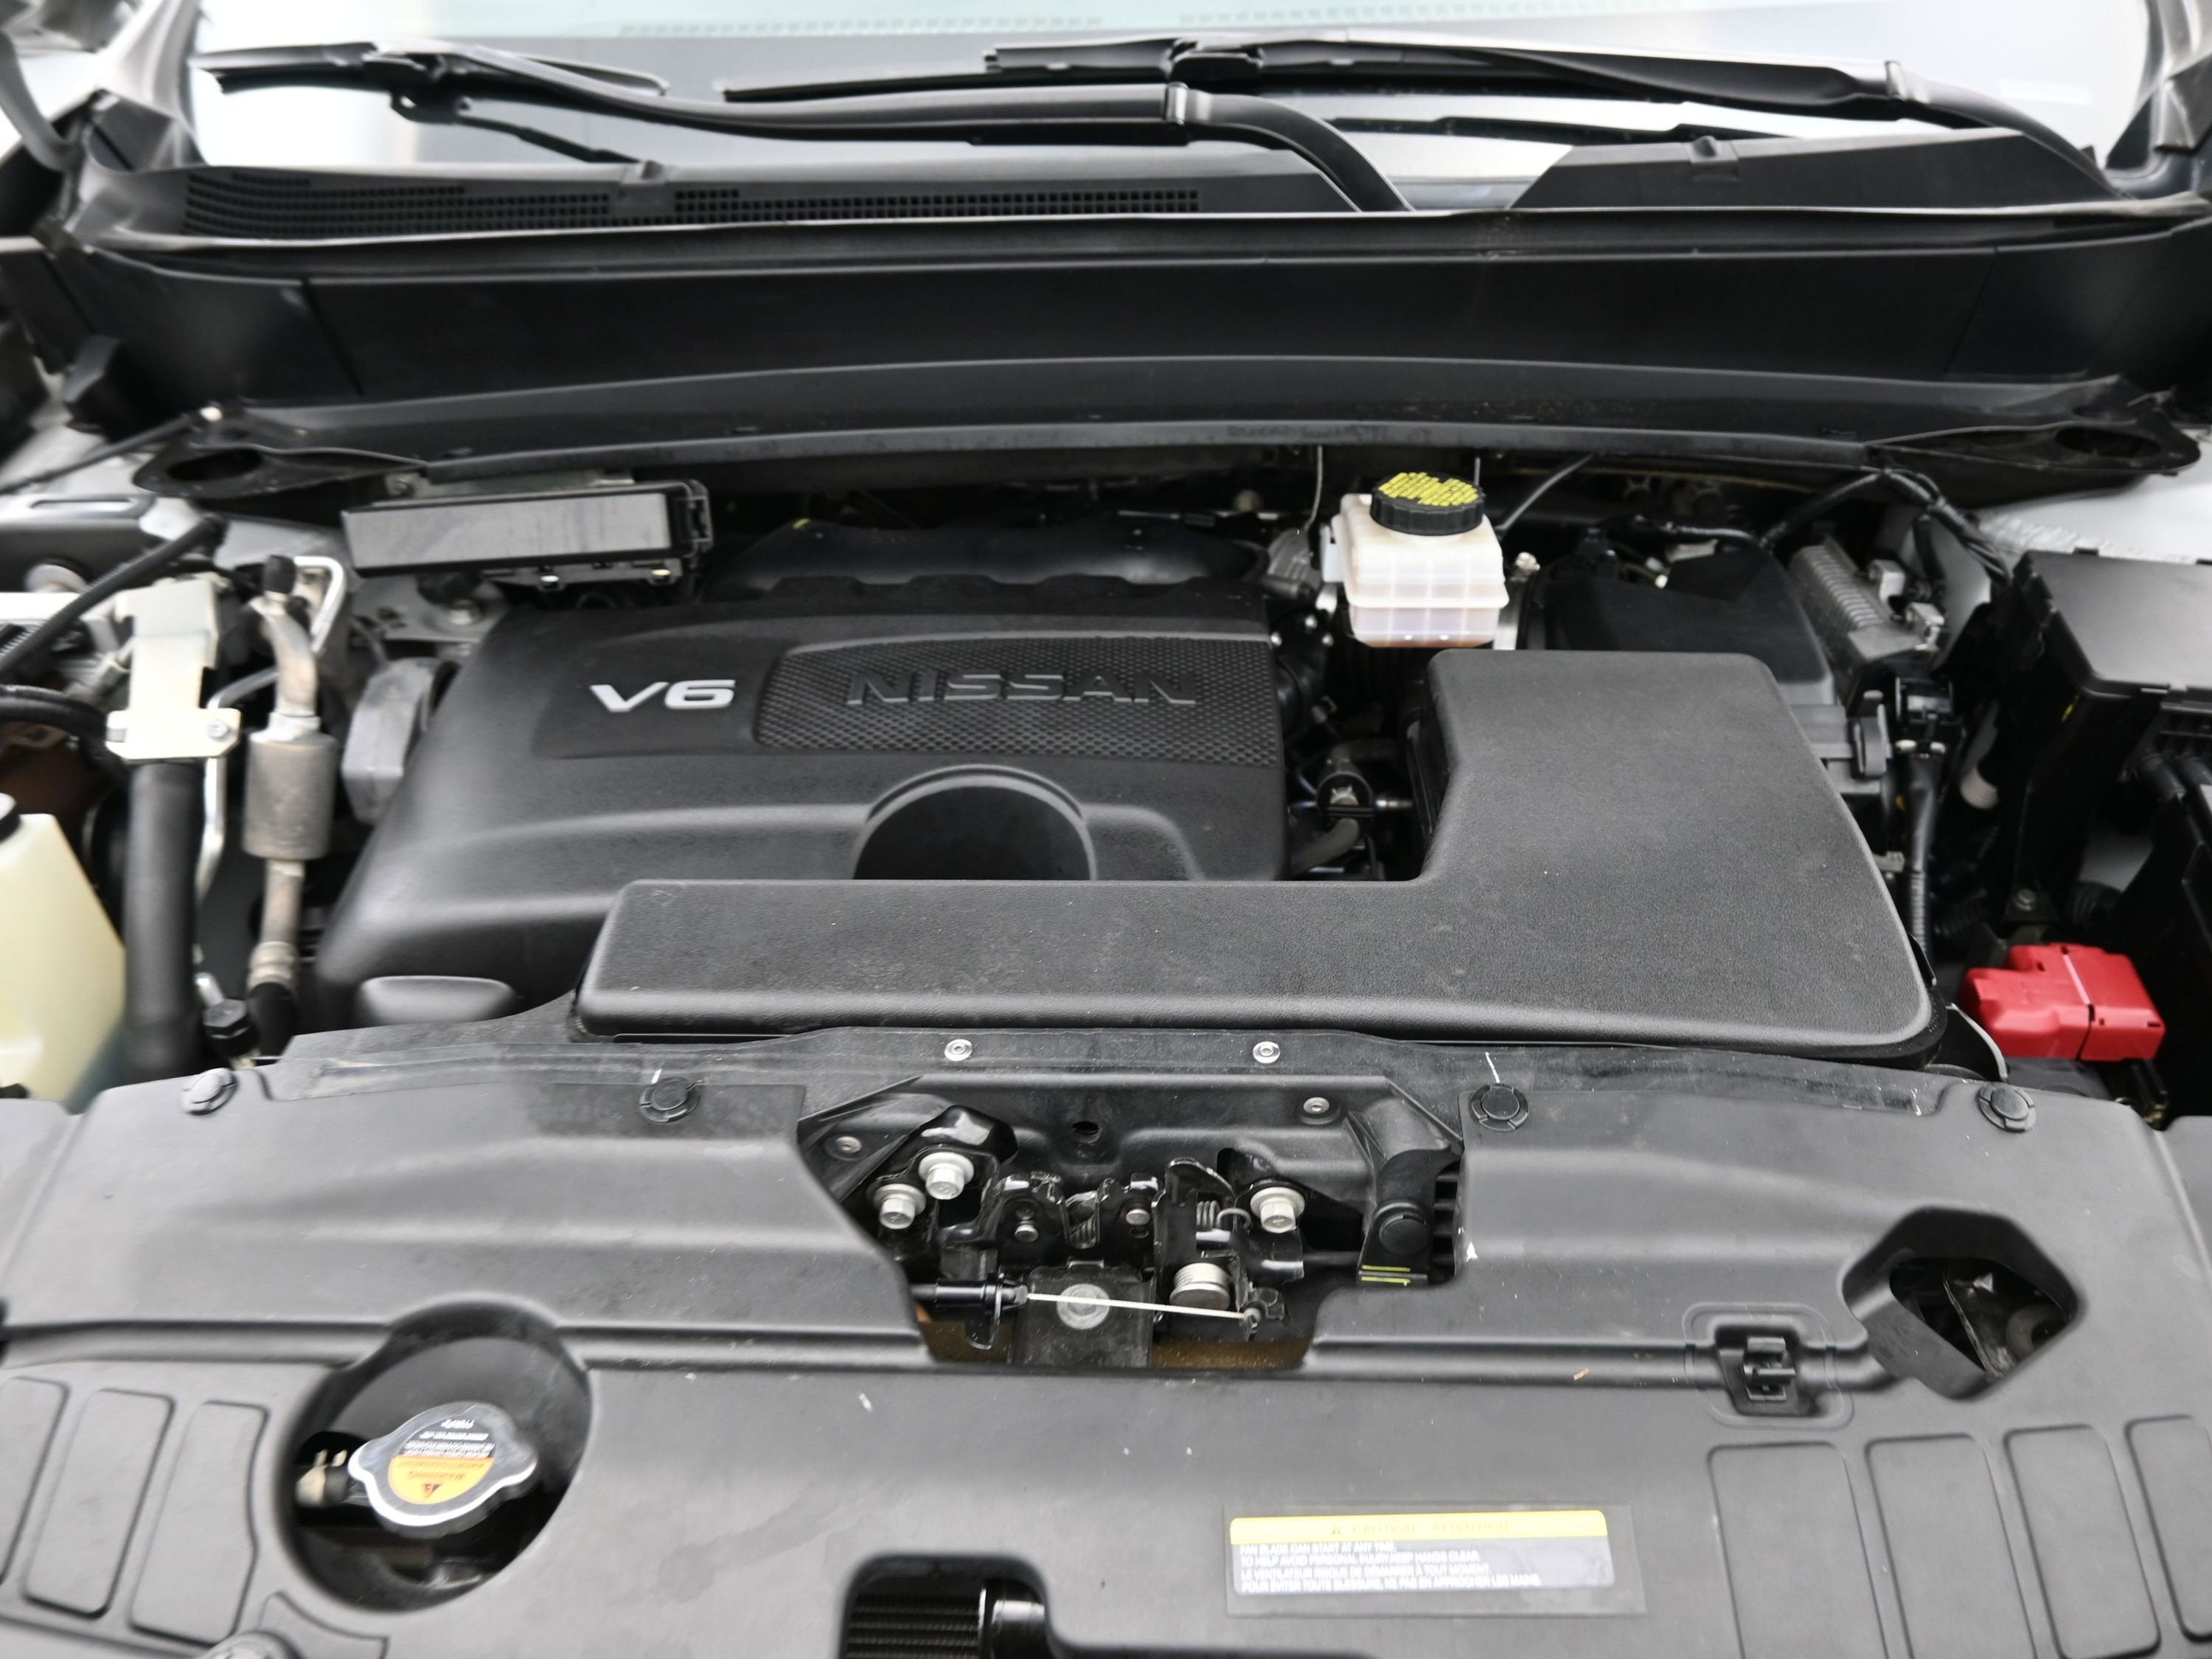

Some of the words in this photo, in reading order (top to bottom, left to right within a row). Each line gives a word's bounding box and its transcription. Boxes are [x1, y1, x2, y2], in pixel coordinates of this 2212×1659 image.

[589, 679, 736, 712] V6
[846, 670, 1197, 706] NISSAN
[1352, 1522, 1416, 1534] CAUTION
[1239, 1544, 1257, 1555] FAN
[1259, 1543, 1288, 1554] BLADE
[1290, 1543, 1310, 1554] CAN
[1312, 1543, 1339, 1554] START
[1341, 1542, 1352, 1553] AT
[1354, 1542, 1372, 1552] ANY
[1241, 1556, 1253, 1568] TO
[1255, 1555, 1279, 1567] HELP
[1280, 1554, 1307, 1566] AVOID
[1415, 1551, 1447, 1563] HANDS
